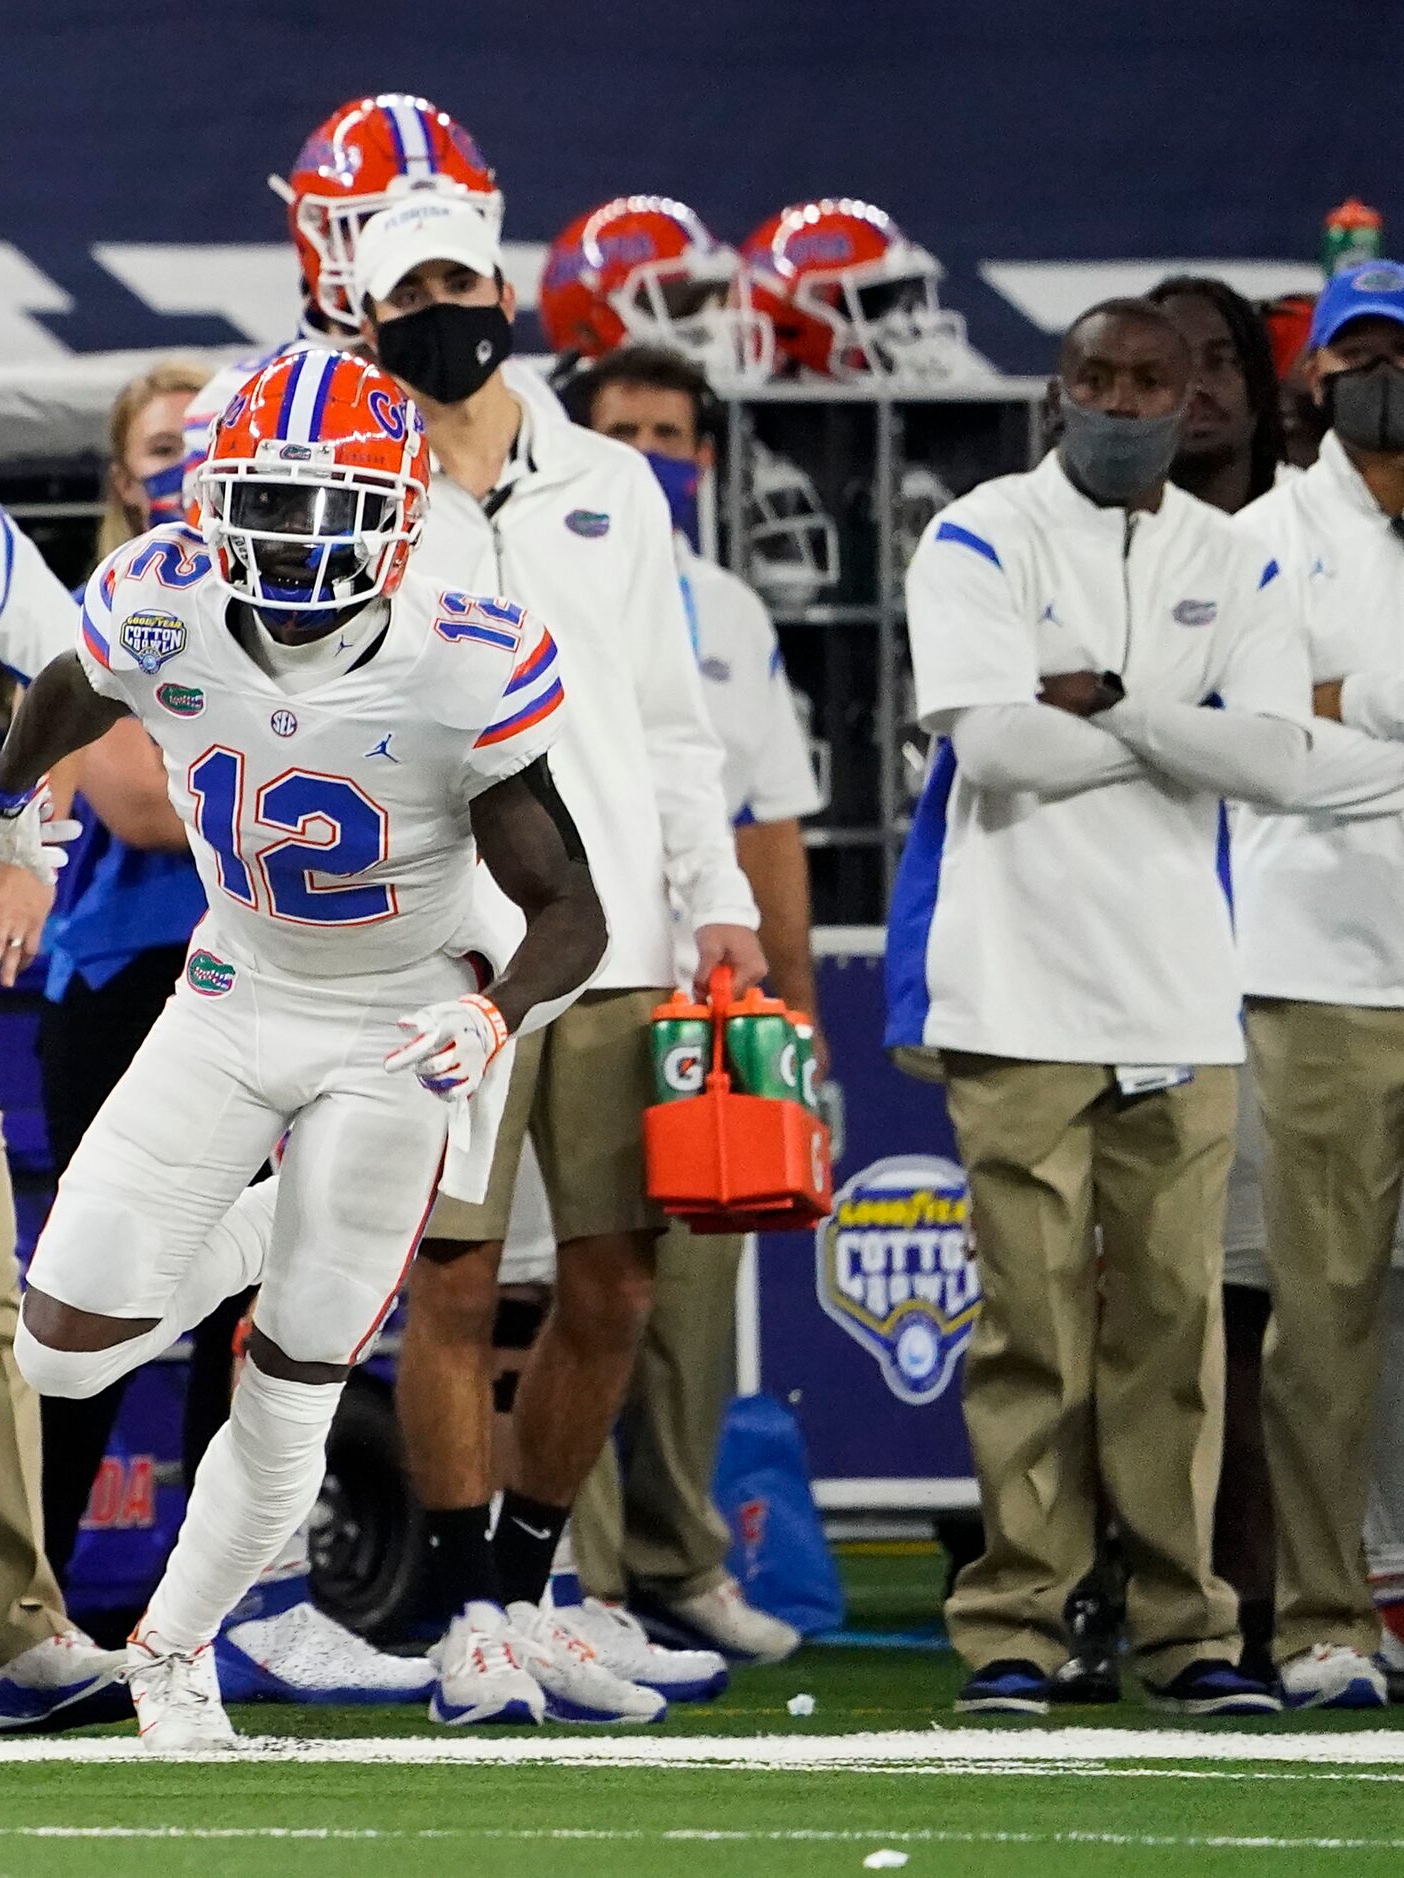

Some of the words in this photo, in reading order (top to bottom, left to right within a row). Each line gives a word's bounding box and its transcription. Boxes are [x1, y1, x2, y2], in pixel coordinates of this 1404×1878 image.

[127, 616, 182, 628] GOODYEAR
[434, 591, 528, 653] 12
[125, 626, 183, 651] COTTON
[133, 638, 170, 653] BOWL
[274, 711, 296, 736] SEC
[188, 744, 399, 928] 12
[663, 1046, 704, 1091] G
